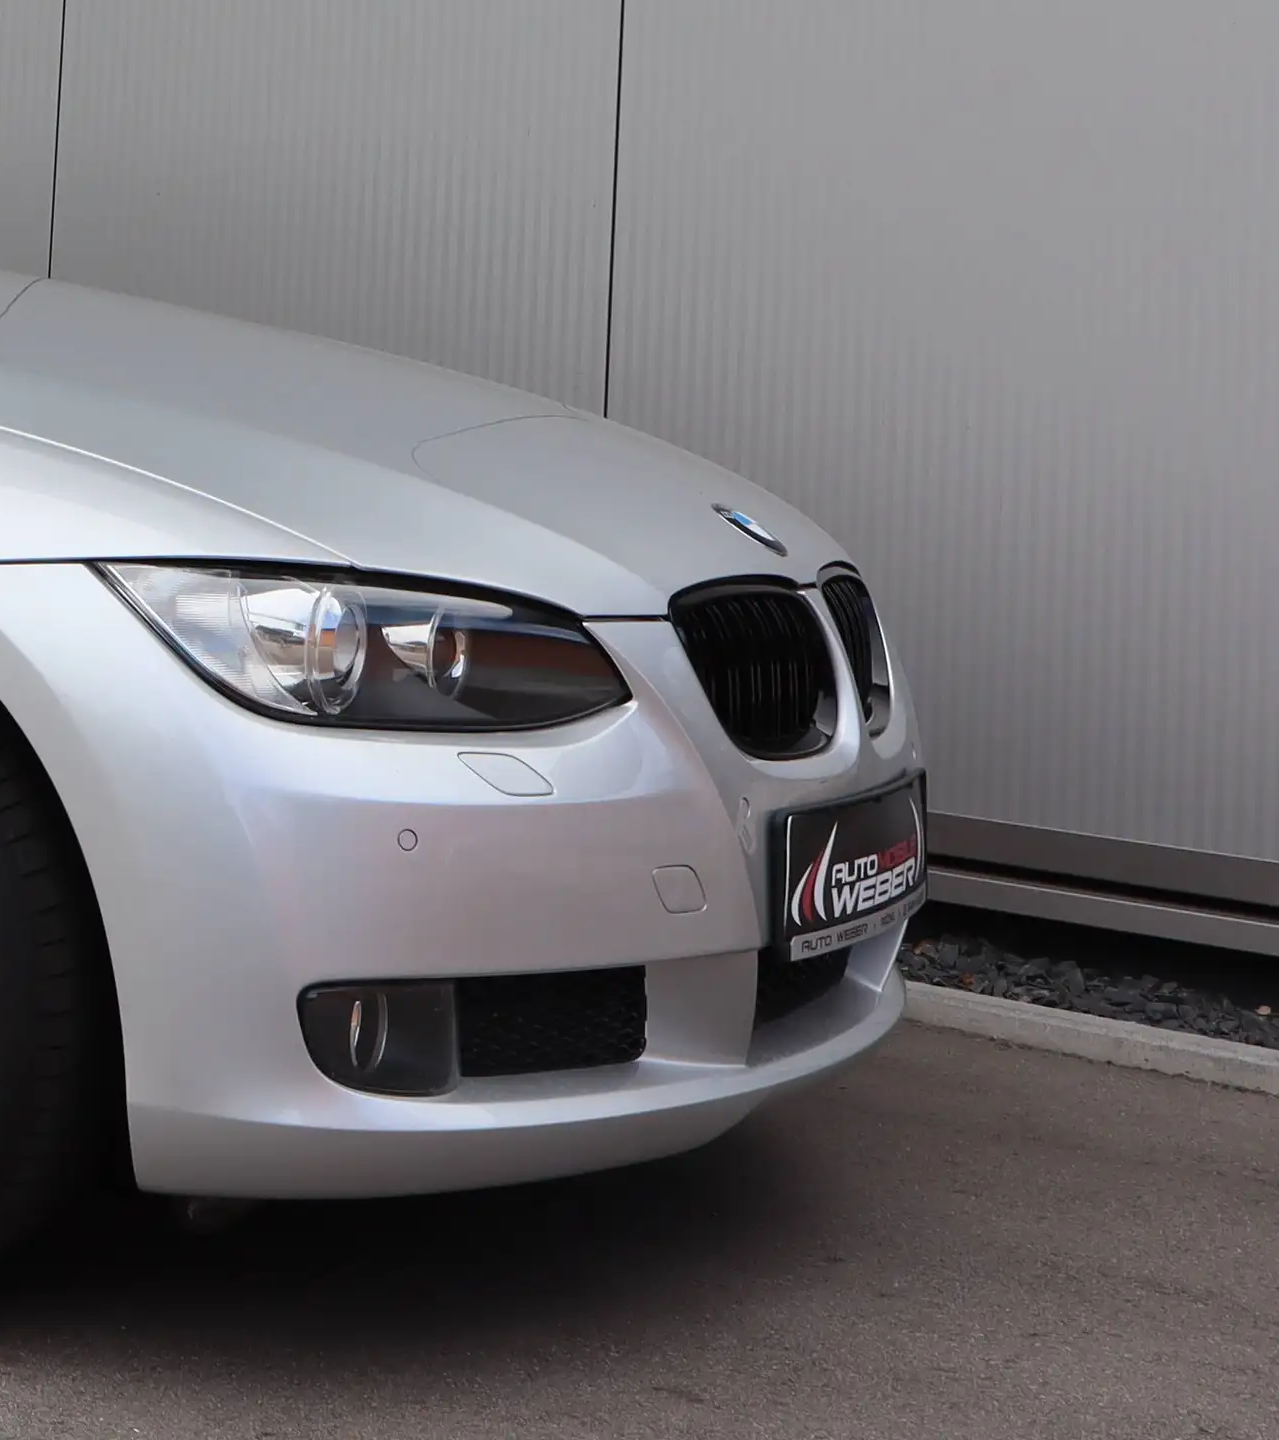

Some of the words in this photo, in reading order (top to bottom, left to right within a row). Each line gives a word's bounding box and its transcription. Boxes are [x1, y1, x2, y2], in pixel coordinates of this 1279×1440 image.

[831, 857, 916, 919] WEBER
[801, 933, 833, 954] AUTO
[836, 923, 869, 943] WEBER
